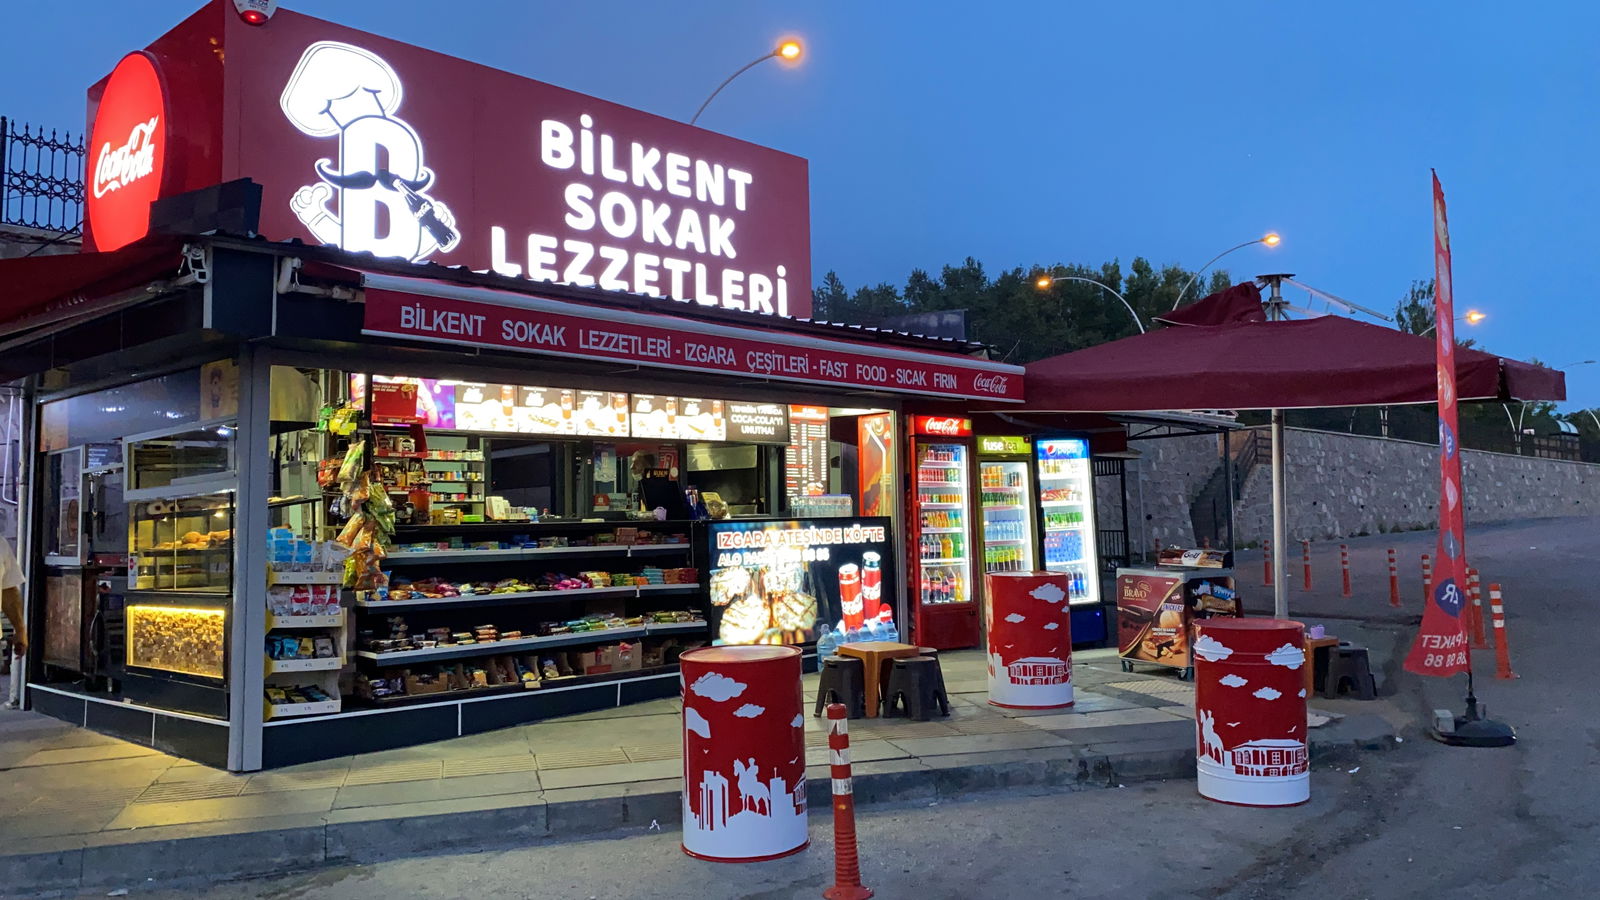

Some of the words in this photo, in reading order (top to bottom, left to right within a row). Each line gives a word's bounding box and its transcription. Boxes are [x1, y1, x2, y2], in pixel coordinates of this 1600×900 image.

[541, 114, 753, 211] BİLKENT
[564, 183, 737, 259] SOKAK
[491, 225, 788, 317] LEZZETLERİ
[400, 302, 486, 337] BİLKENT
[501, 319, 567, 347] SOKAK
[578, 329, 671, 359] LEZZETLERİ
[684, 342, 737, 367] IZGARA
[746, 350, 809, 376] ÇEŞİTLERİ
[820, 359, 849, 379] FAST
[856, 364, 887, 383] FOOD
[896, 368, 927, 387] SICAK
[934, 372, 957, 390] FIRIN
[717, 529, 774, 549] IZGARA
[844, 524, 885, 544] KÖFTE
